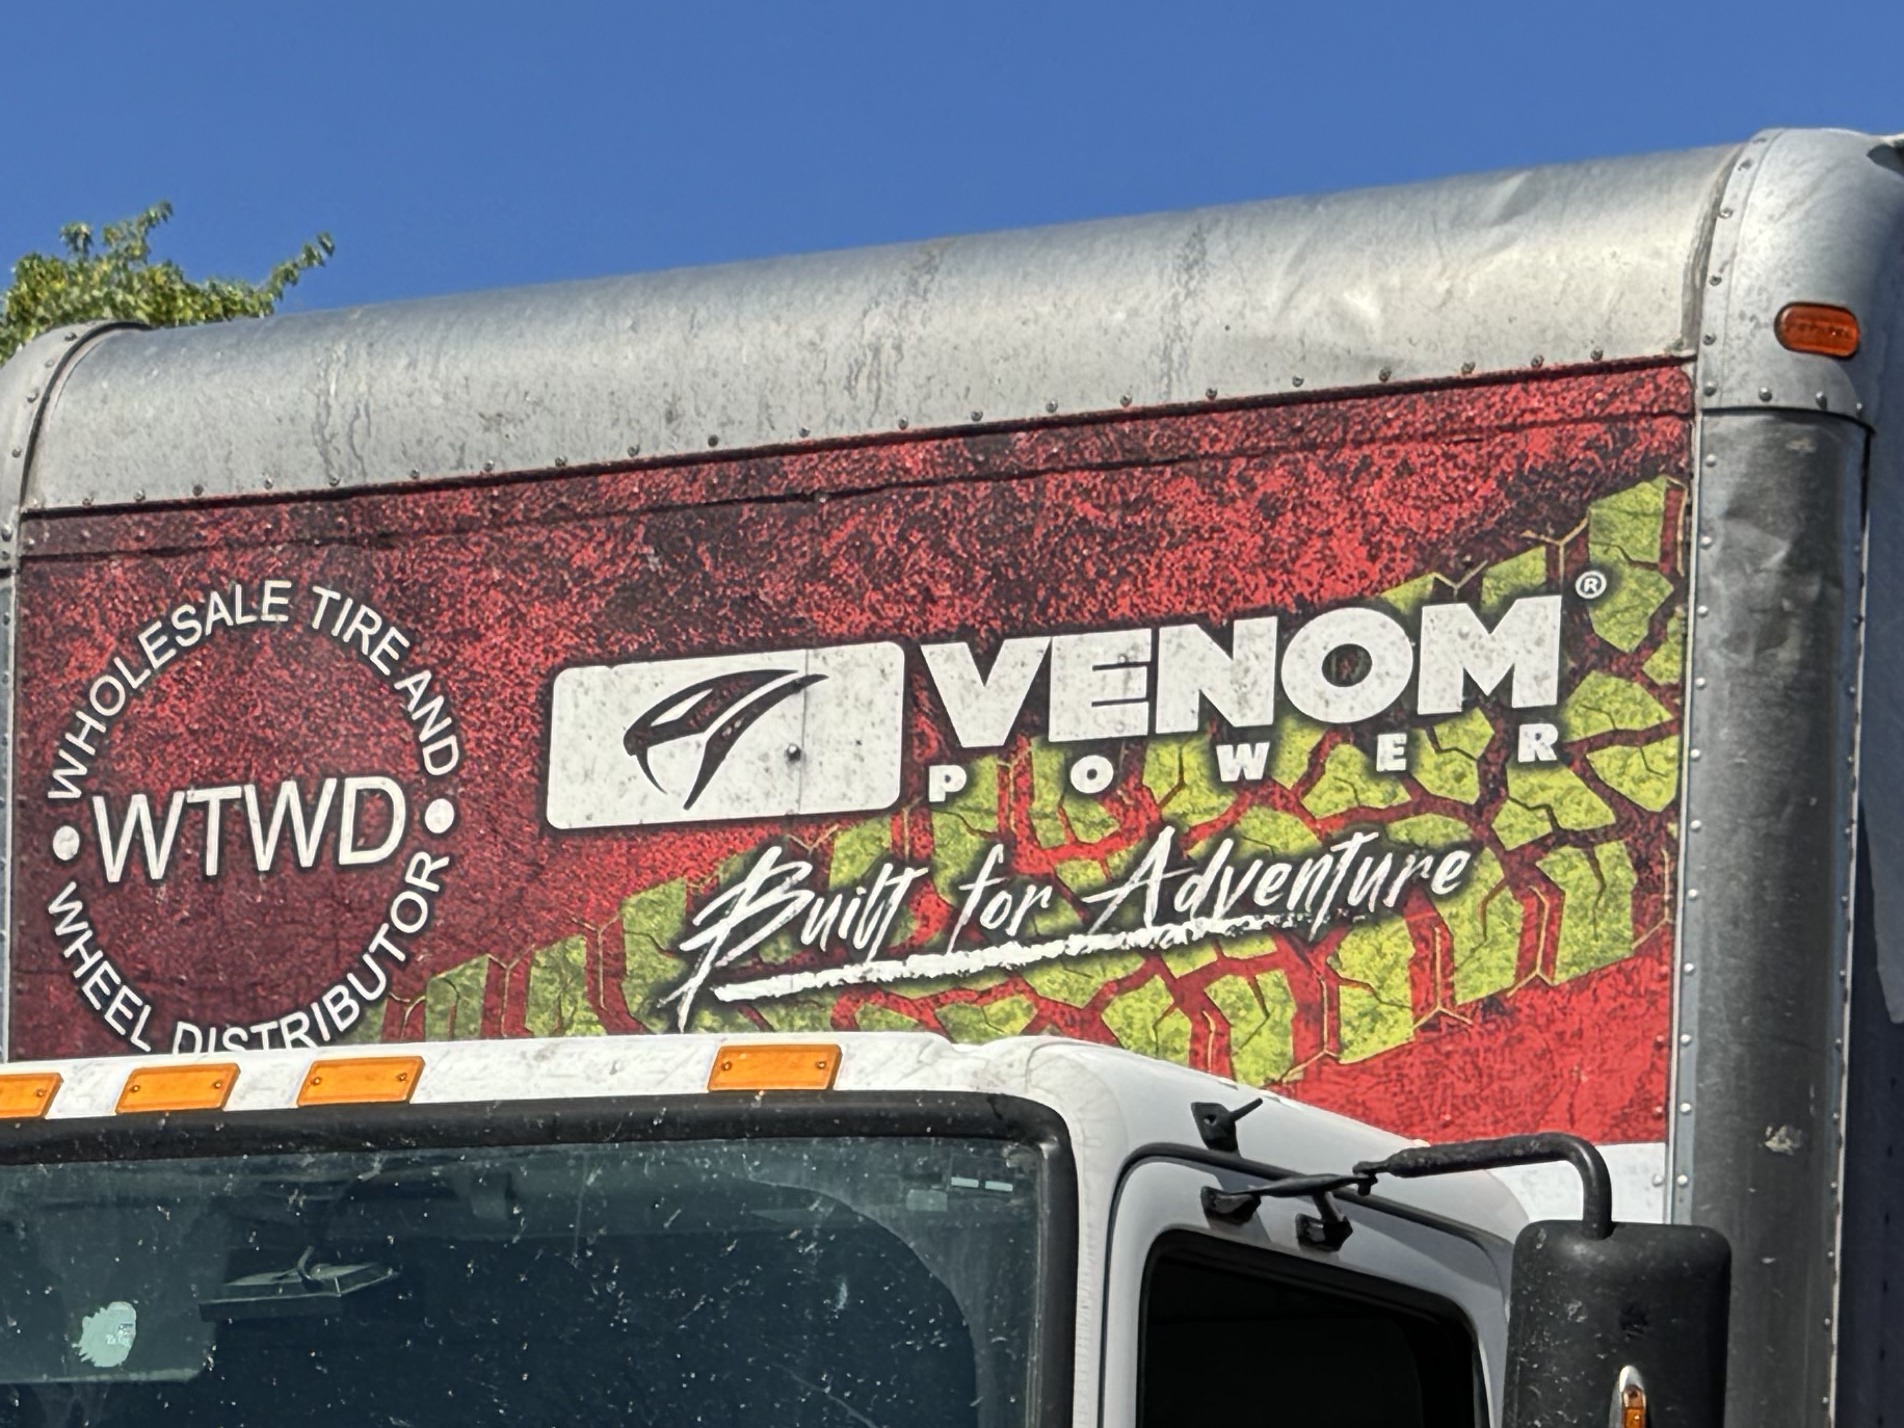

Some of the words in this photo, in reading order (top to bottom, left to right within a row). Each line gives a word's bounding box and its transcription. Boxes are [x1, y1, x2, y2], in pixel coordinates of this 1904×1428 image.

[48, 579, 292, 799] WHOLESALE
[311, 585, 410, 676] TIRE
[394, 670, 460, 776] AND
[920, 594, 1563, 749] VENOM
[92, 776, 407, 883] WTWD
[928, 723, 1559, 804] POWER
[48, 881, 152, 1052] WHEEL
[173, 850, 450, 1054] DISTRIBUTOR
[658, 845, 928, 1032] Built
[948, 845, 1053, 954] for
[1082, 825, 1473, 941] Adventure
